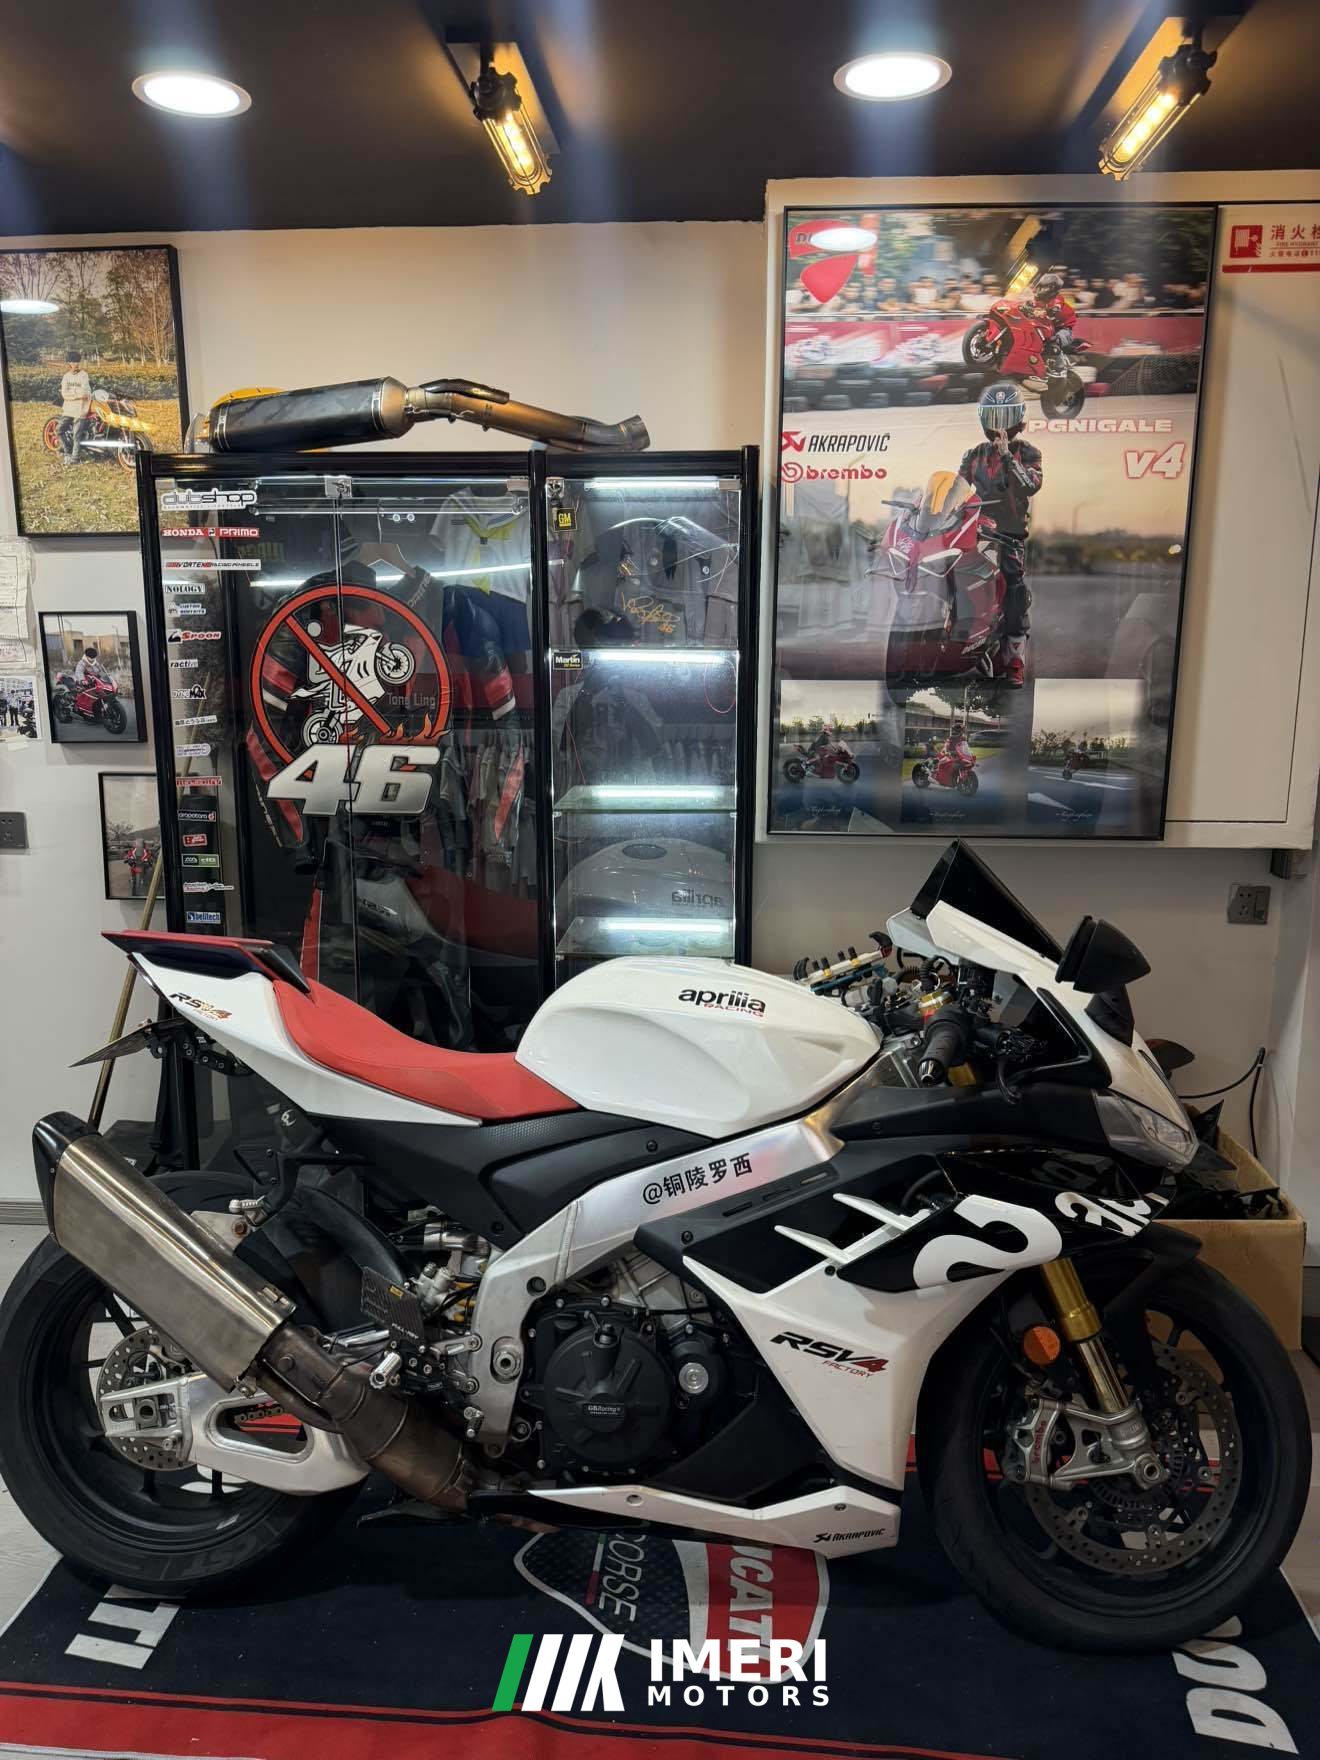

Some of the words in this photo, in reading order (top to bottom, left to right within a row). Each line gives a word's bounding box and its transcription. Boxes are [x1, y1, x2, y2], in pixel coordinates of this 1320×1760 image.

[806, 465, 887, 480] brembo
[558, 512, 572, 526] GM
[162, 528, 205, 537] HONDA
[219, 528, 259, 537] PRIMO
[166, 584, 204, 593] NOLOGY
[266, 743, 441, 817] 46
[678, 988, 767, 1014] aprilia
[703, 1003, 765, 1018] RACING
[642, 1152, 753, 1205] @铜陵罗西
[769, 1331, 889, 1373] RSV4
[821, 1360, 875, 1379] FACTORY
